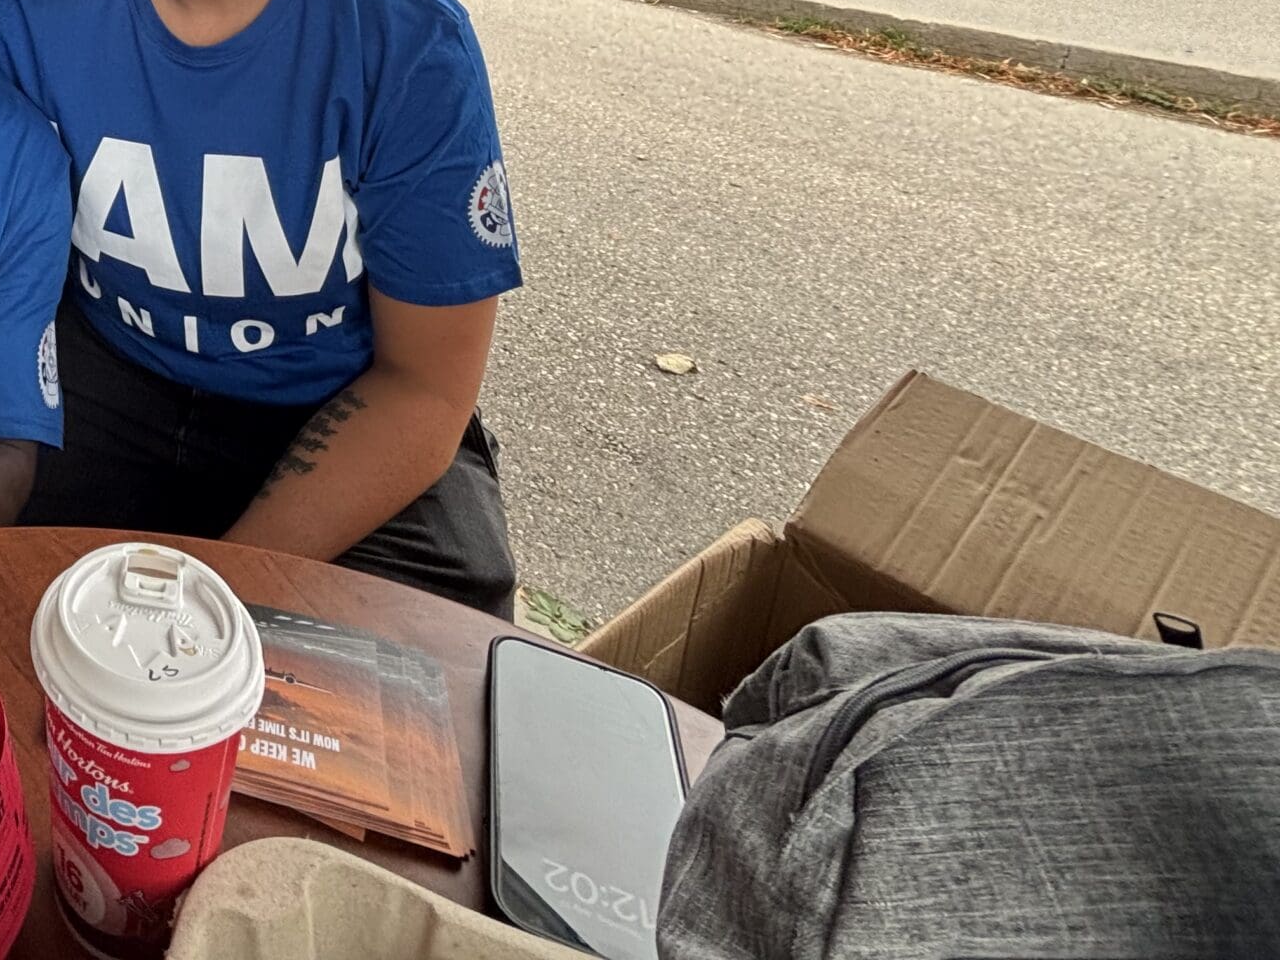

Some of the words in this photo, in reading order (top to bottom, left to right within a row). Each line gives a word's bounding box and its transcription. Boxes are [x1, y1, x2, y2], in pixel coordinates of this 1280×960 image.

[257, 718, 288, 738] TIME
[288, 726, 311, 744] IT'S
[250, 738, 289, 762] KEEP
[313, 733, 342, 753] NOW
[57, 728, 130, 793] Hortons
[291, 747, 317, 770] WE
[81, 781, 163, 831] des
[542, 857, 658, 929] 12:02
